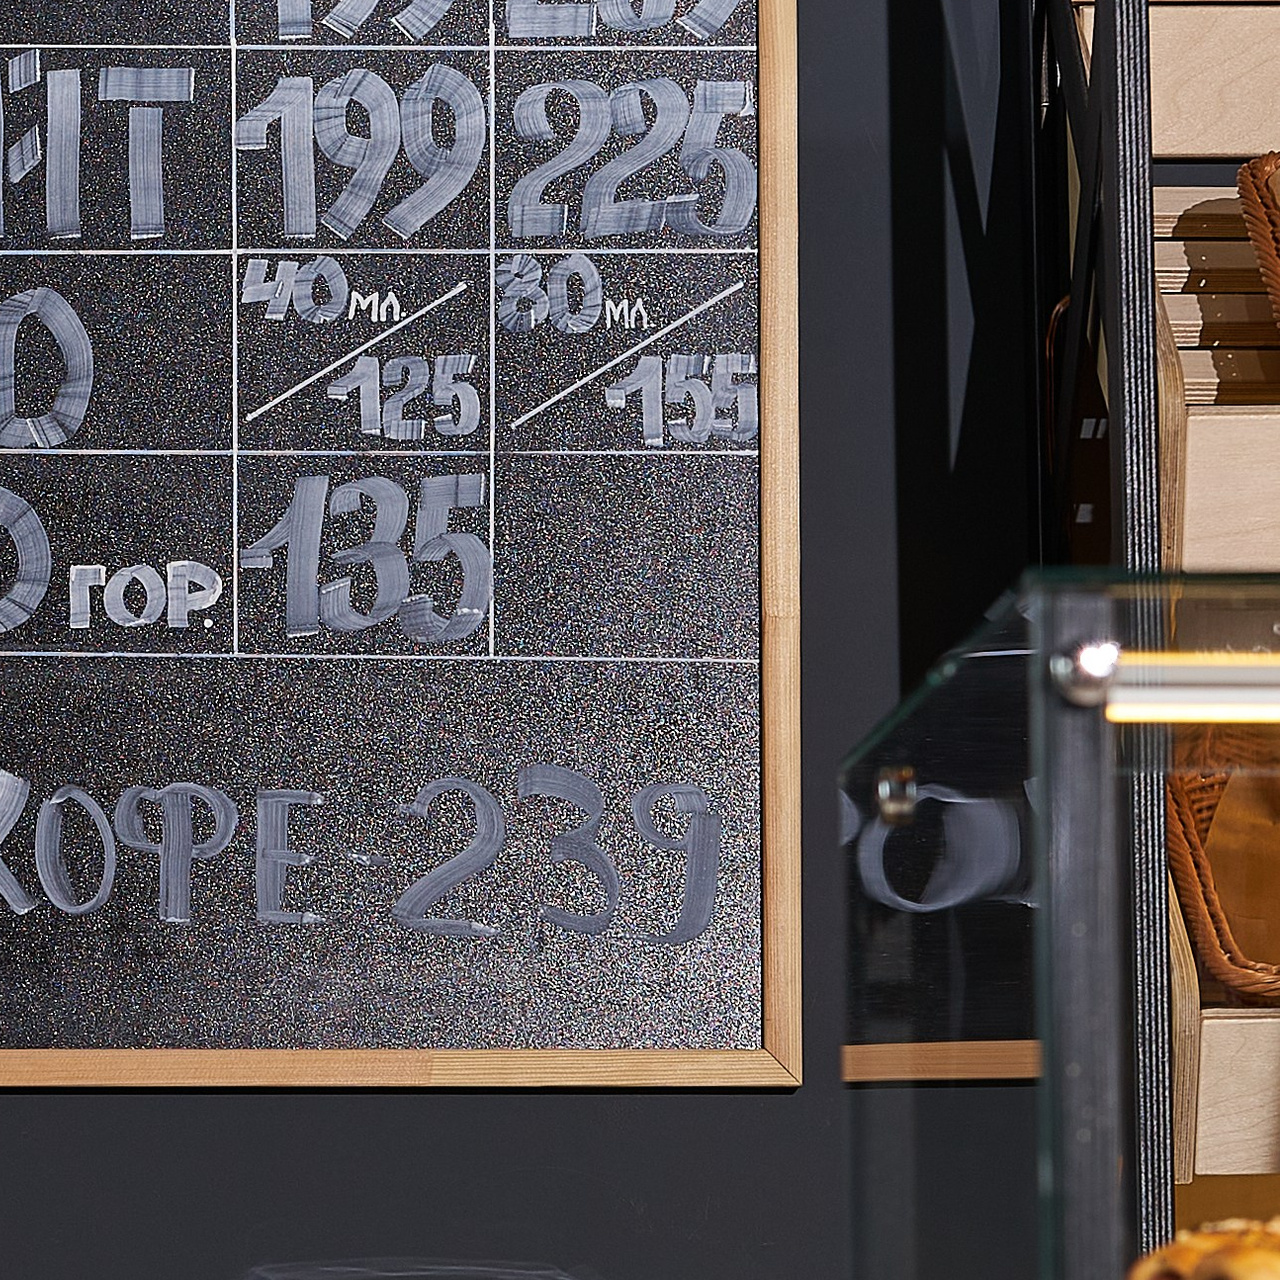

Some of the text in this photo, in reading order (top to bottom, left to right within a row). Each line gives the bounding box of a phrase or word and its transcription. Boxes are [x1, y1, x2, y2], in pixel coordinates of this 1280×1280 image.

[235, 63, 486, 241] 199
[510, 77, 756, 241] 225
[242, 255, 349, 323] 40
[496, 252, 603, 334] 80
[327, 354, 481, 441] 125
[605, 353, 757, 448] 155
[240, 474, 492, 642] 135
[389, 763, 721, 946] 239
